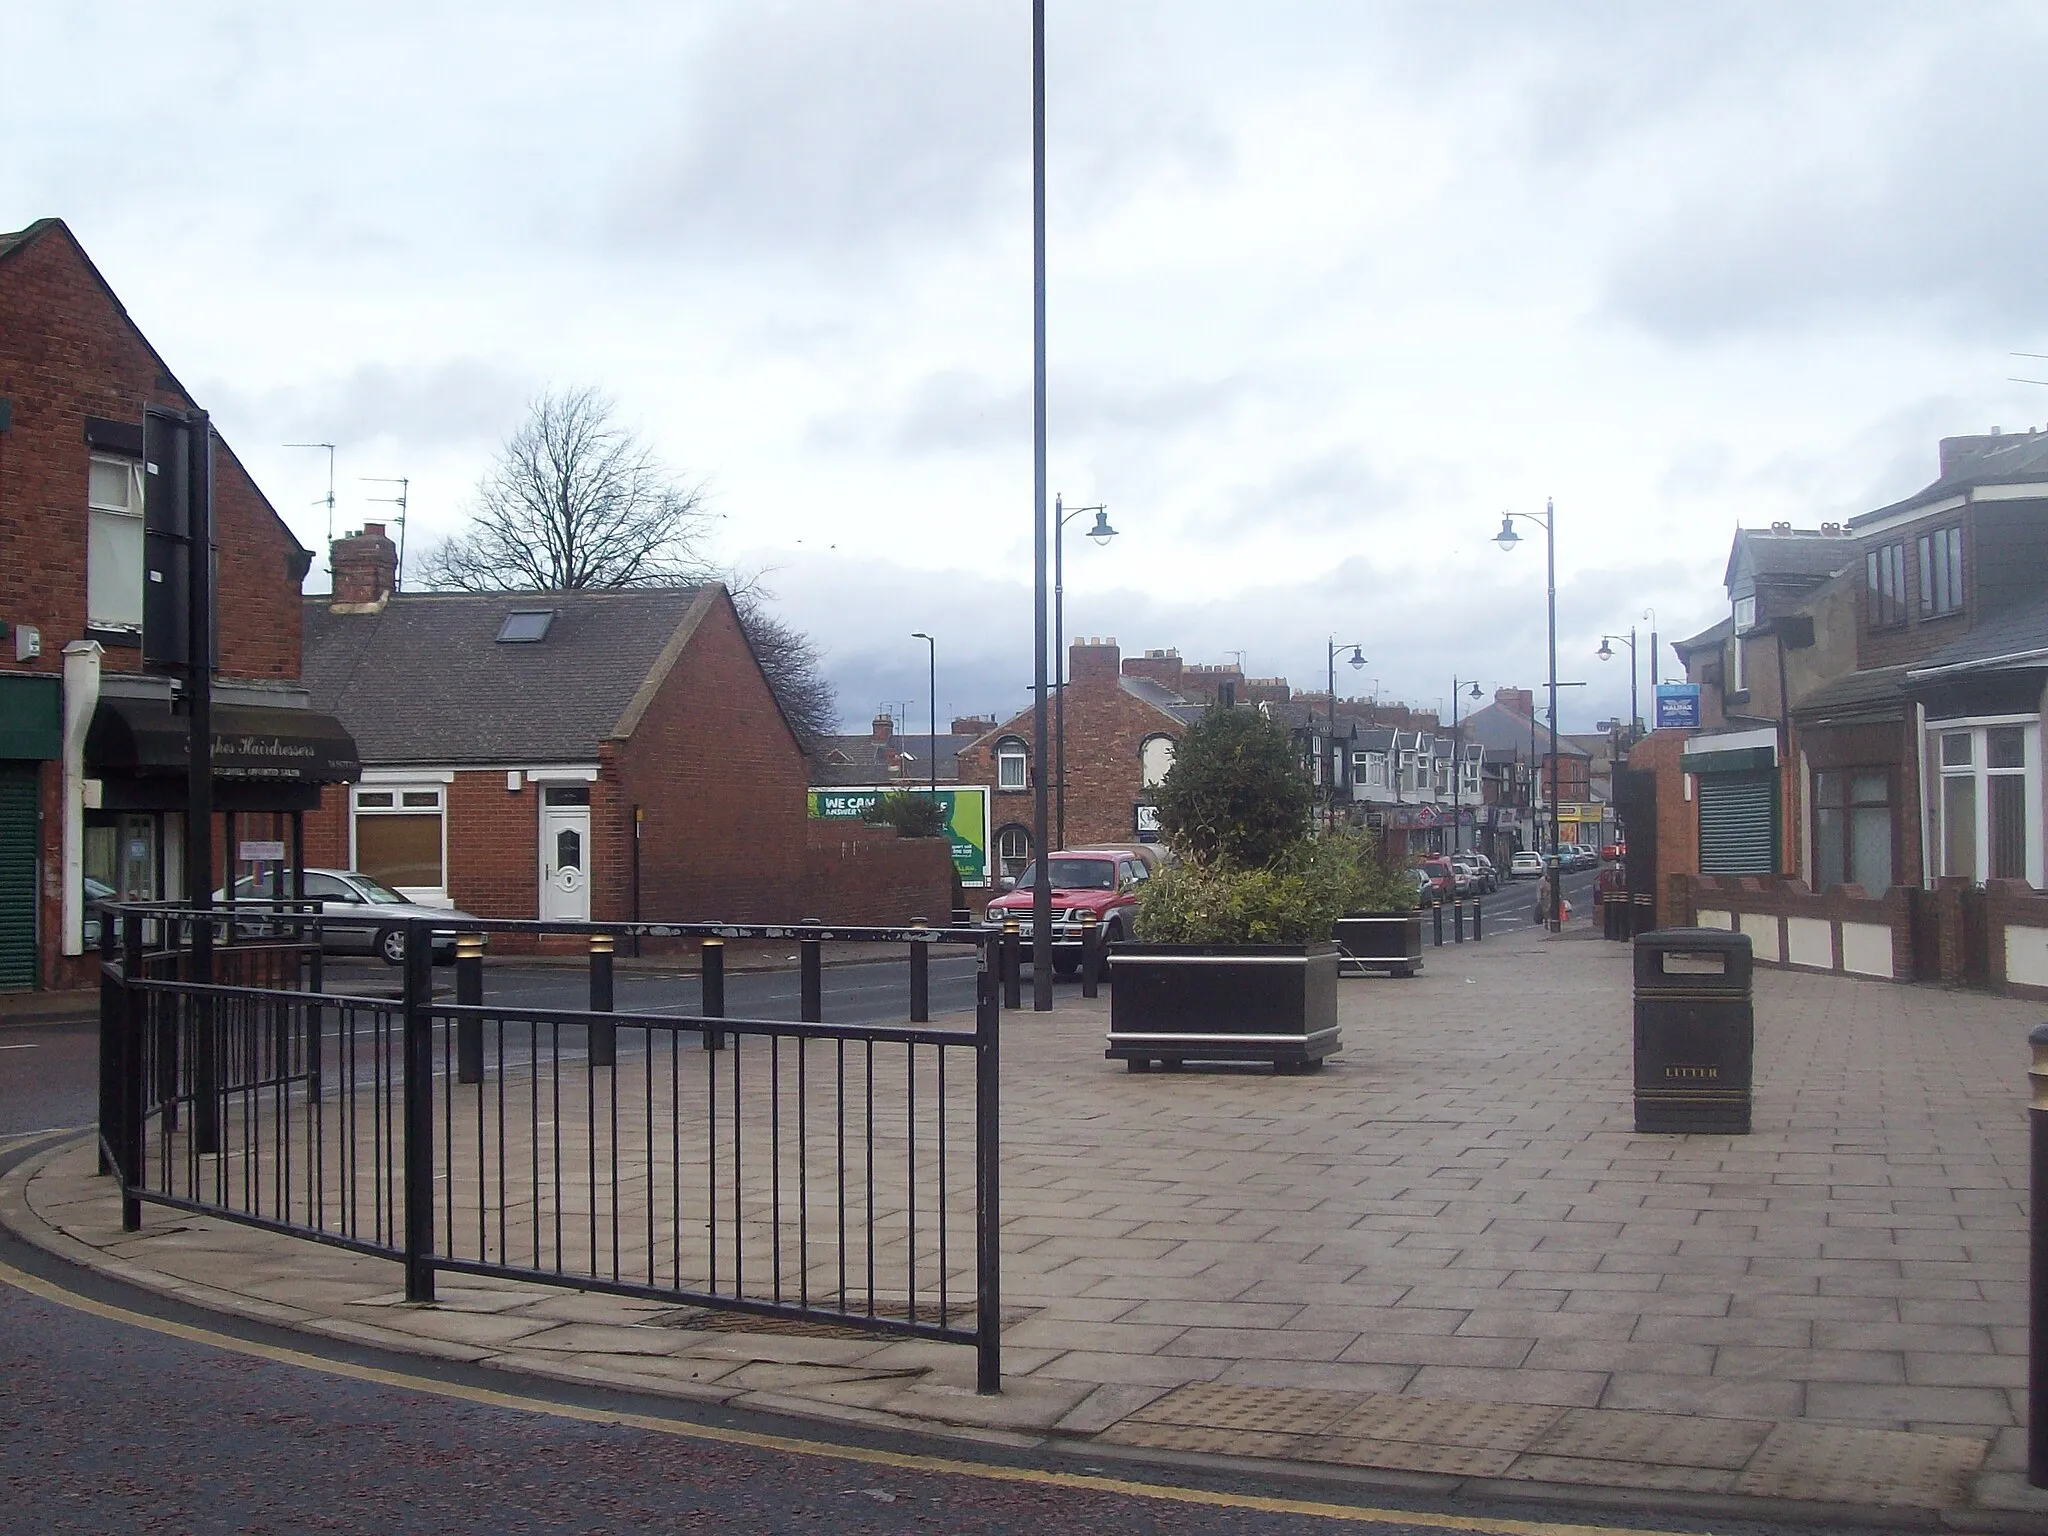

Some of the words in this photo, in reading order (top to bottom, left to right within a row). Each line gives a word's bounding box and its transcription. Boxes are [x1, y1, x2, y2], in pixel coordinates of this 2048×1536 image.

[238, 736, 316, 757] Hairdressers
[825, 797, 845, 809] WE
[847, 797, 876, 808] CAN
[1665, 1067, 1718, 1077] LITTER
